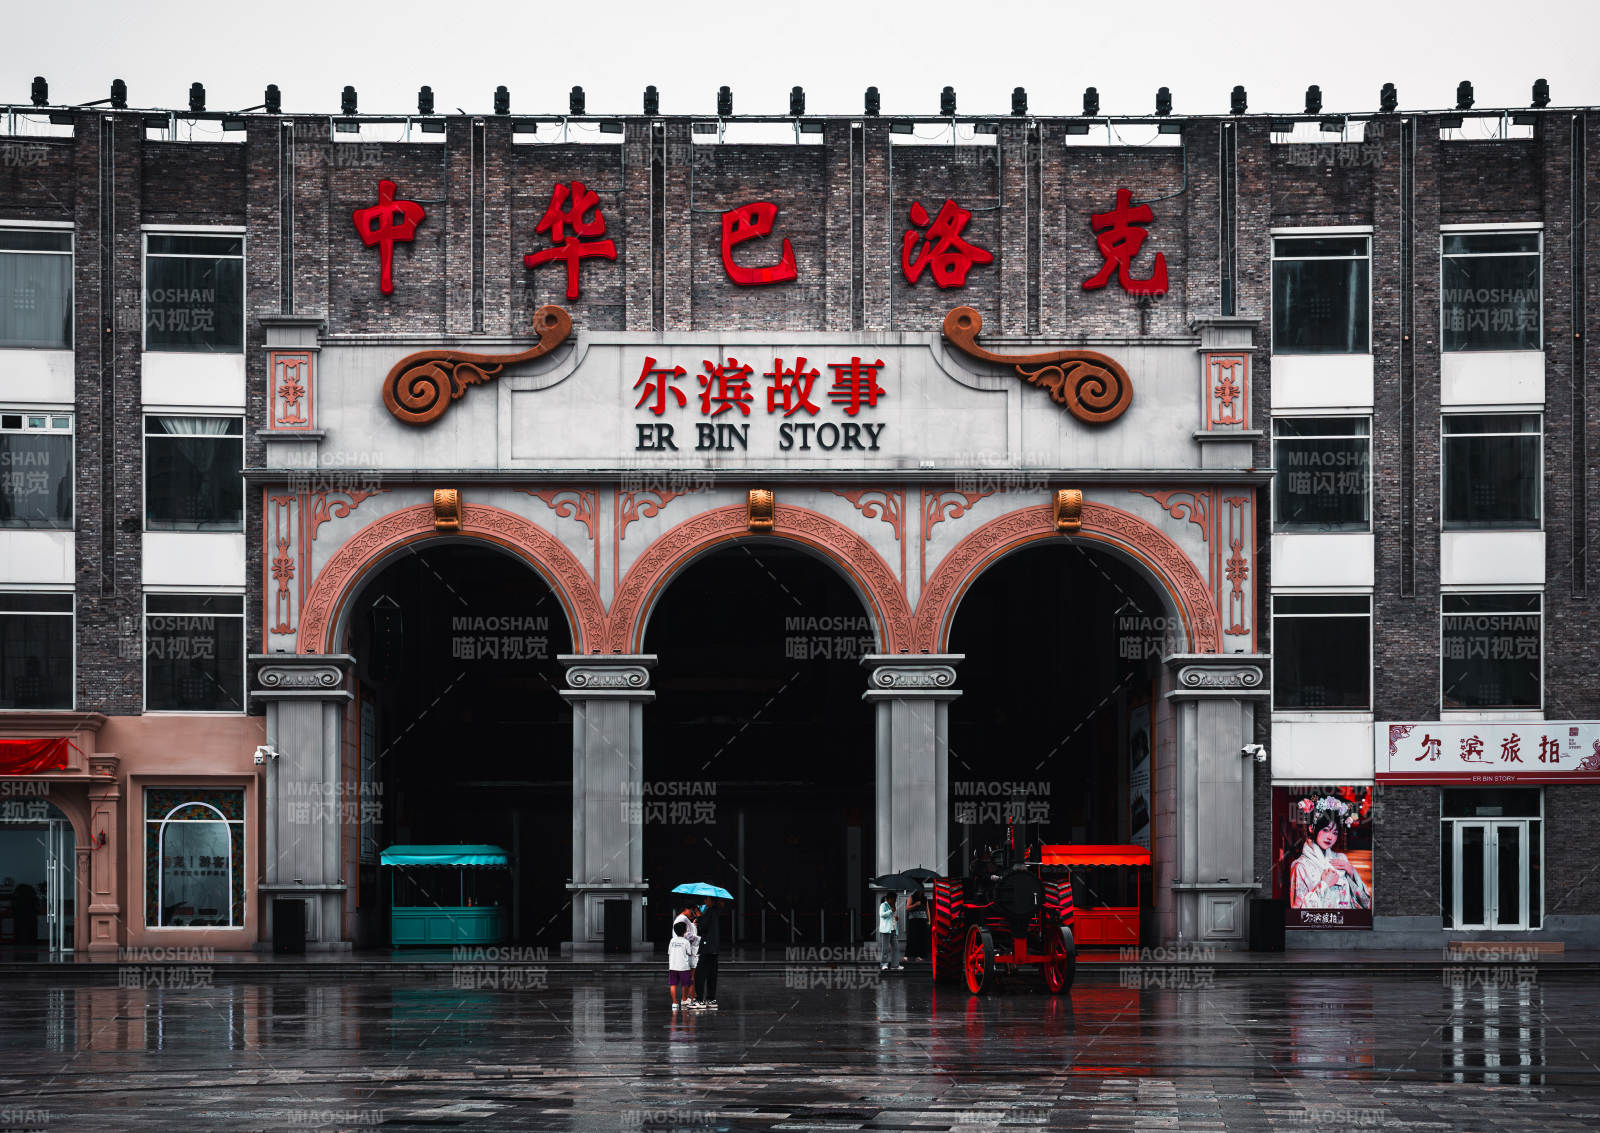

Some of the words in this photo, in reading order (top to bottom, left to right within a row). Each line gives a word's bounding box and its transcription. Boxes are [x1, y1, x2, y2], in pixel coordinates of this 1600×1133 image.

[353, 179, 1168, 300] 中华巴洛克
[633, 356, 886, 417] 尔滨故事
[635, 423, 679, 451] ER
[695, 423, 750, 451] BIN
[779, 422, 886, 451] STORY
